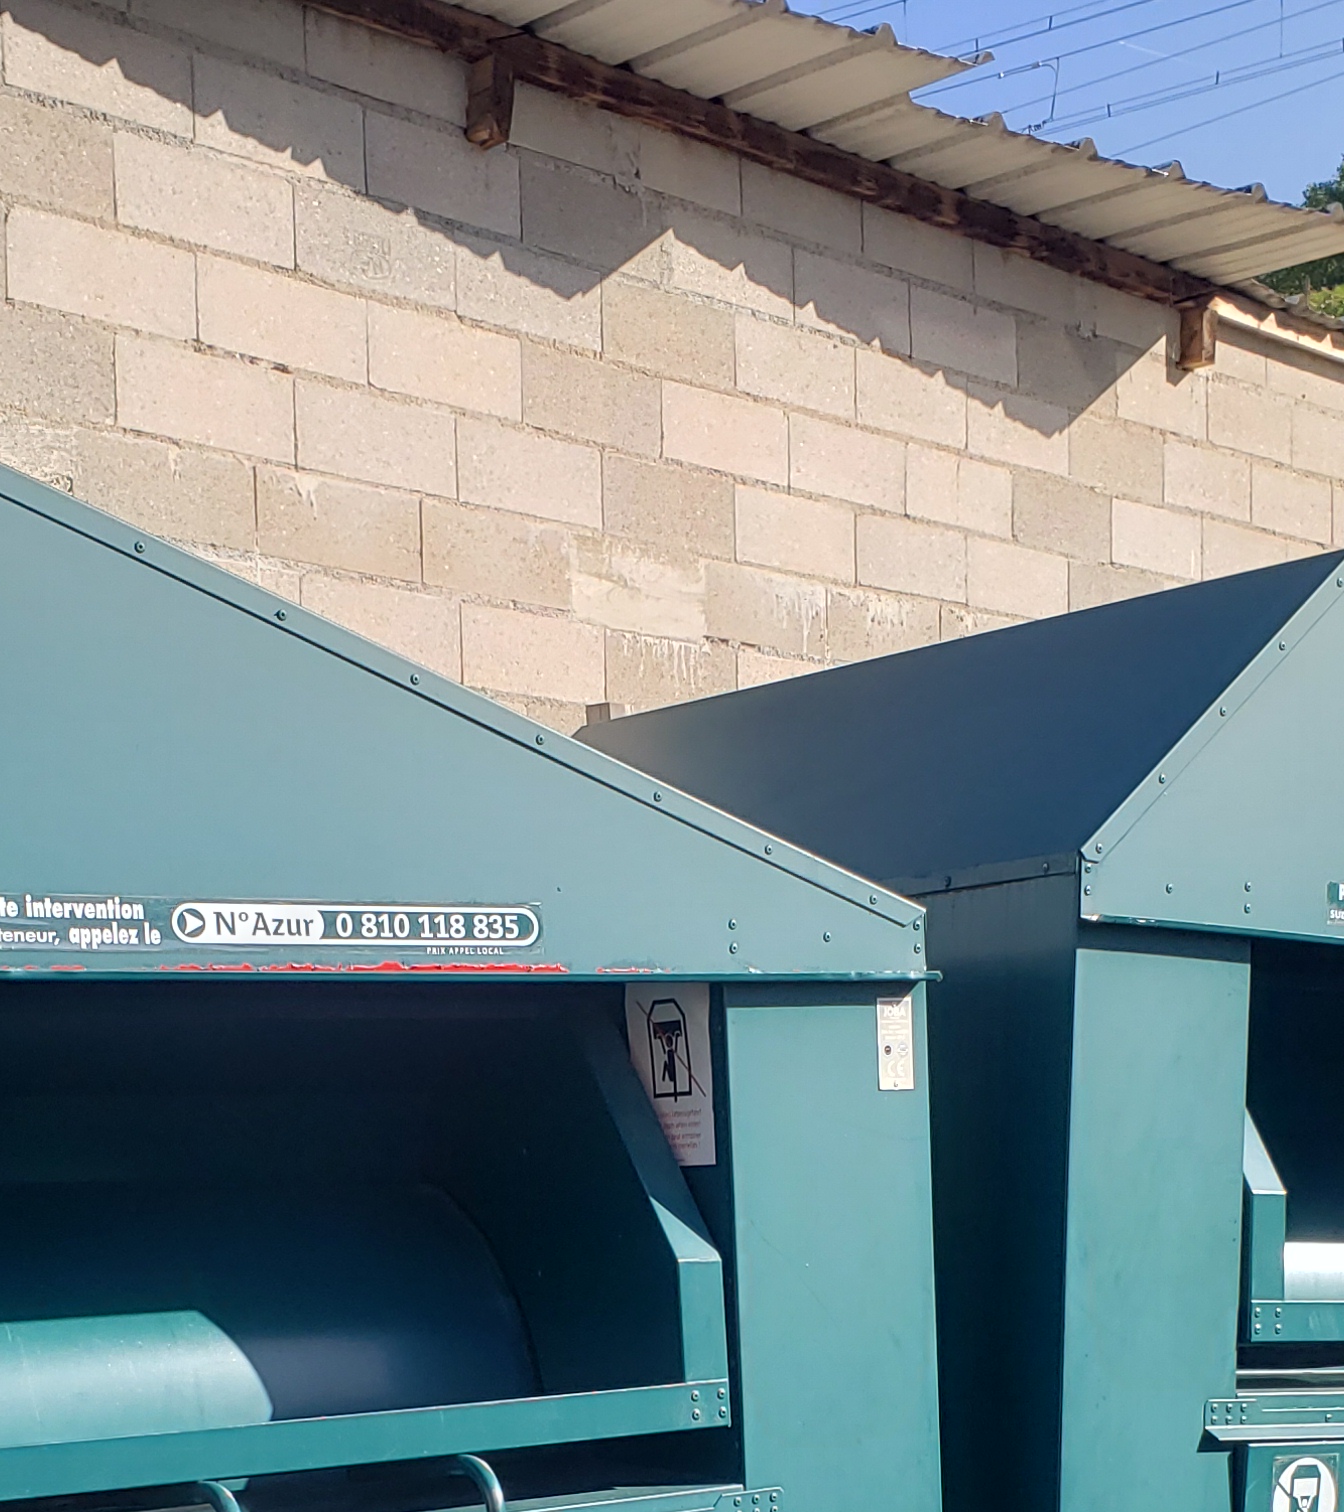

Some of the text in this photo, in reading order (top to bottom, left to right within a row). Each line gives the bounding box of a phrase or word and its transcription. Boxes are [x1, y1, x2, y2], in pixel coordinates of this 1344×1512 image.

[26, 895, 144, 919] intervention
[69, 922, 139, 949] appelez
[144, 922, 161, 944] le
[336, 913, 353, 937] 0
[361, 913, 407, 938] 810
[418, 914, 466, 938] 118
[473, 914, 519, 939] 835
